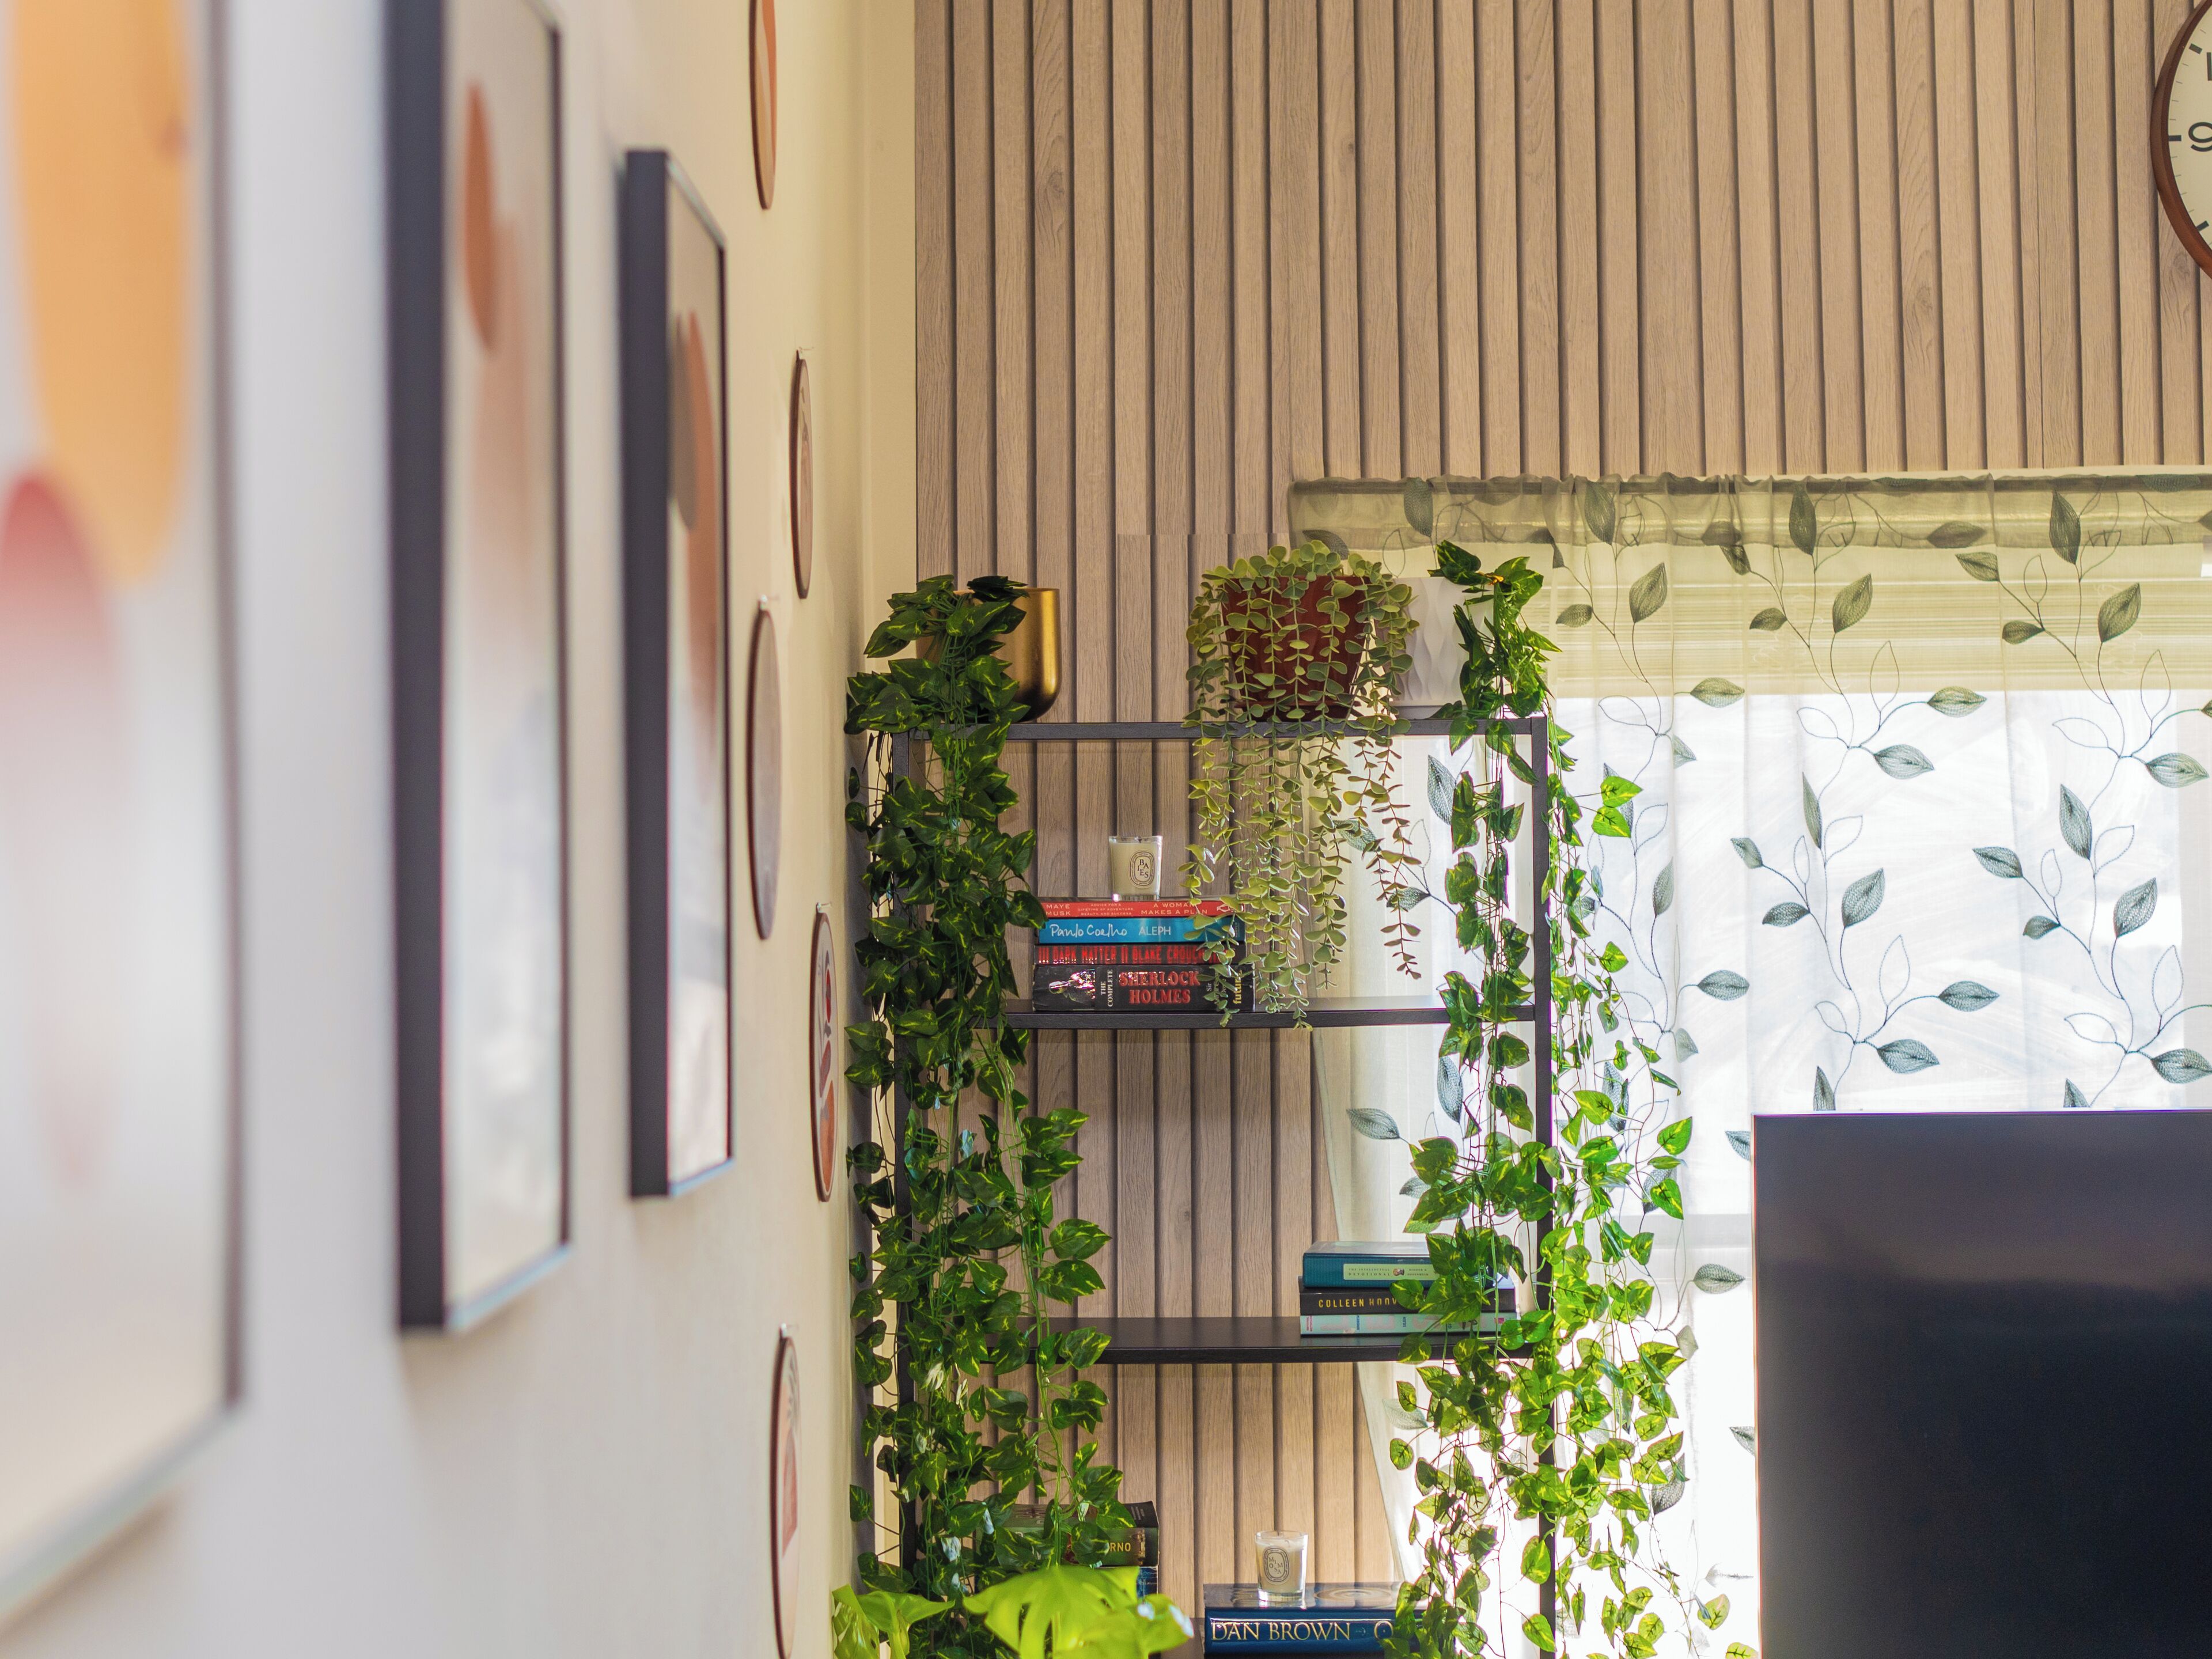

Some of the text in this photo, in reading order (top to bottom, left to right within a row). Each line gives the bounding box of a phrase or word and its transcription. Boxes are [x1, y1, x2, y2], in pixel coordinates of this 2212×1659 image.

[2188, 122, 2212, 152] 9
[1050, 922, 1171, 937] Paulo Coelho ALEPH
[1052, 945, 1077, 964] DARK
[1081, 945, 1116, 964] MATTER
[1132, 945, 1162, 964] BLAKE
[1119, 971, 1200, 986] SHERLOCK
[1128, 988, 1191, 1003] HOLMES
[1319, 1297, 1397, 1308] COLLEEN HOOV
[1211, 1622, 1260, 1641] DAN
[1268, 1622, 1351, 1641] BROWN
